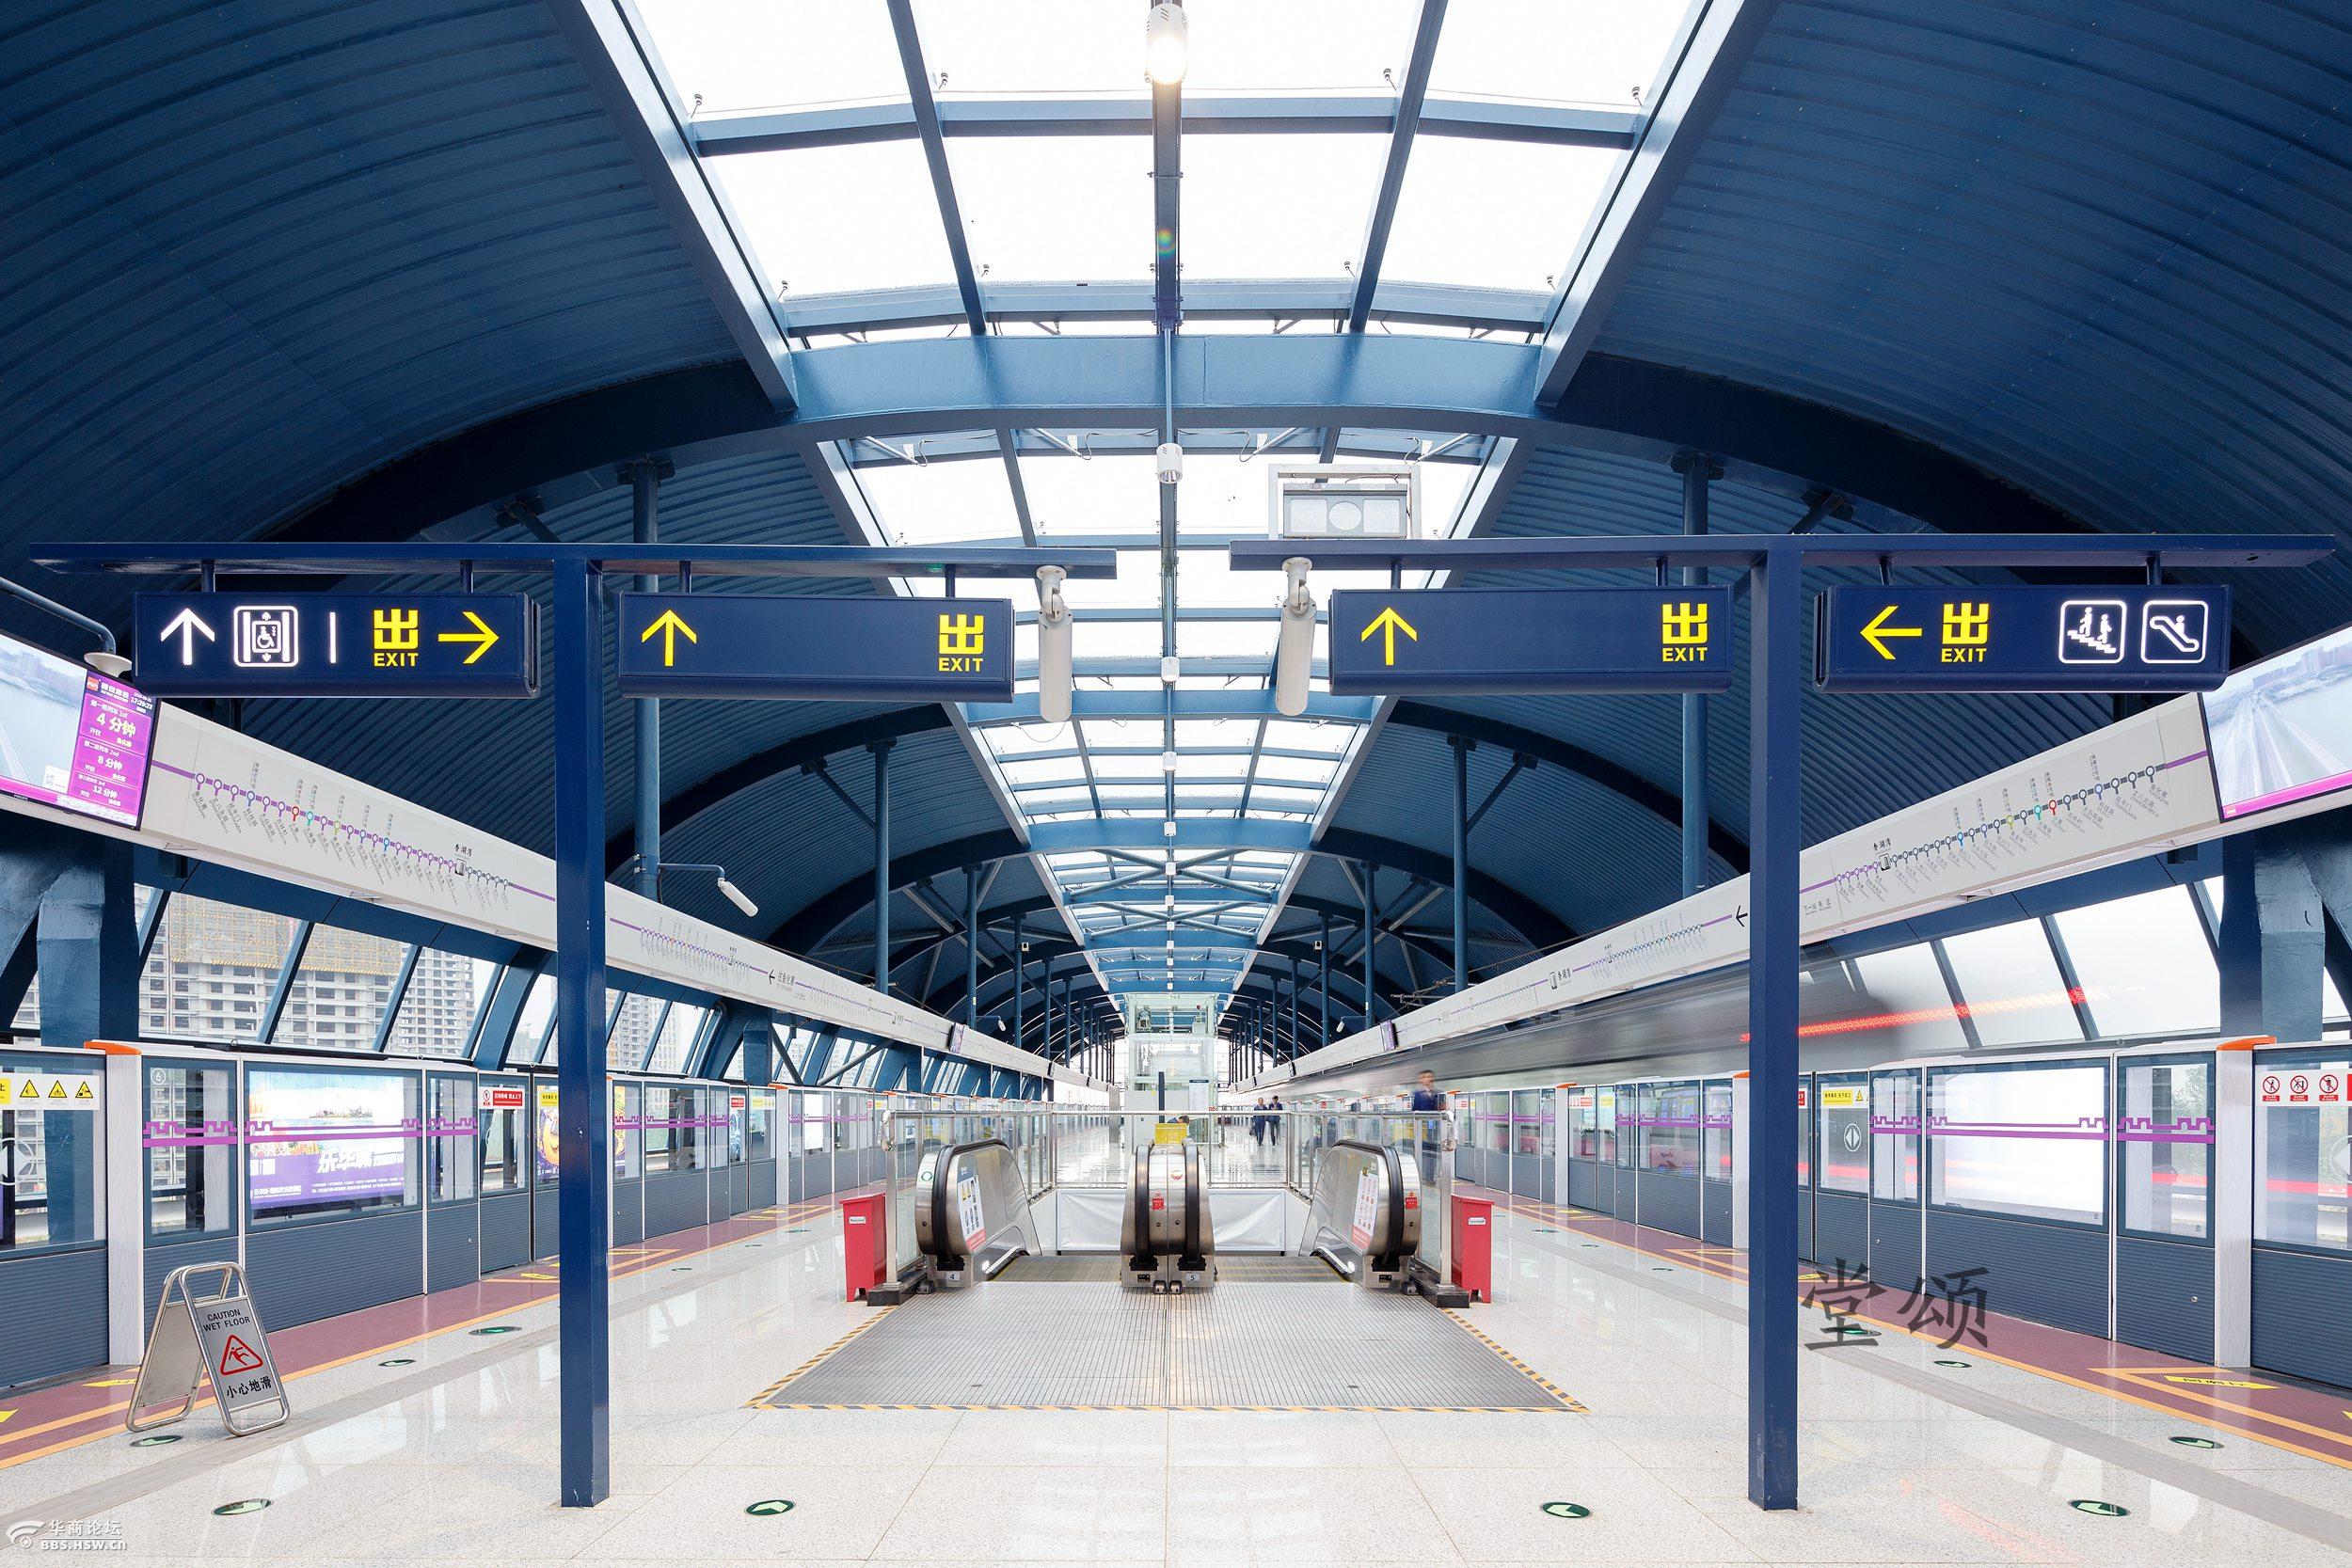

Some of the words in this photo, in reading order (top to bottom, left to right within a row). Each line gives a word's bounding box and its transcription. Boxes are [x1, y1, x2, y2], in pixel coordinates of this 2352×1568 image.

[373, 609, 419, 650] 出
[1661, 602, 1708, 644] 出
[1942, 602, 1990, 645] 出
[939, 613, 984, 655] 出
[373, 652, 419, 667] EXIT
[1661, 647, 1708, 662] EXIT
[1941, 648, 1988, 663] EXIT
[938, 657, 984, 673] EXIT
[96, 712, 106, 726] 4
[108, 717, 136, 737] 分钟
[97, 755, 104, 765] 8
[104, 757, 123, 771] 分钟
[93, 785, 103, 795] 12
[207, 1308, 241, 1322] CAUTION
[203, 1322, 224, 1332] WET
[224, 1316, 251, 1328] FLOOR
[227, 1376, 272, 1399] 小心地滑
